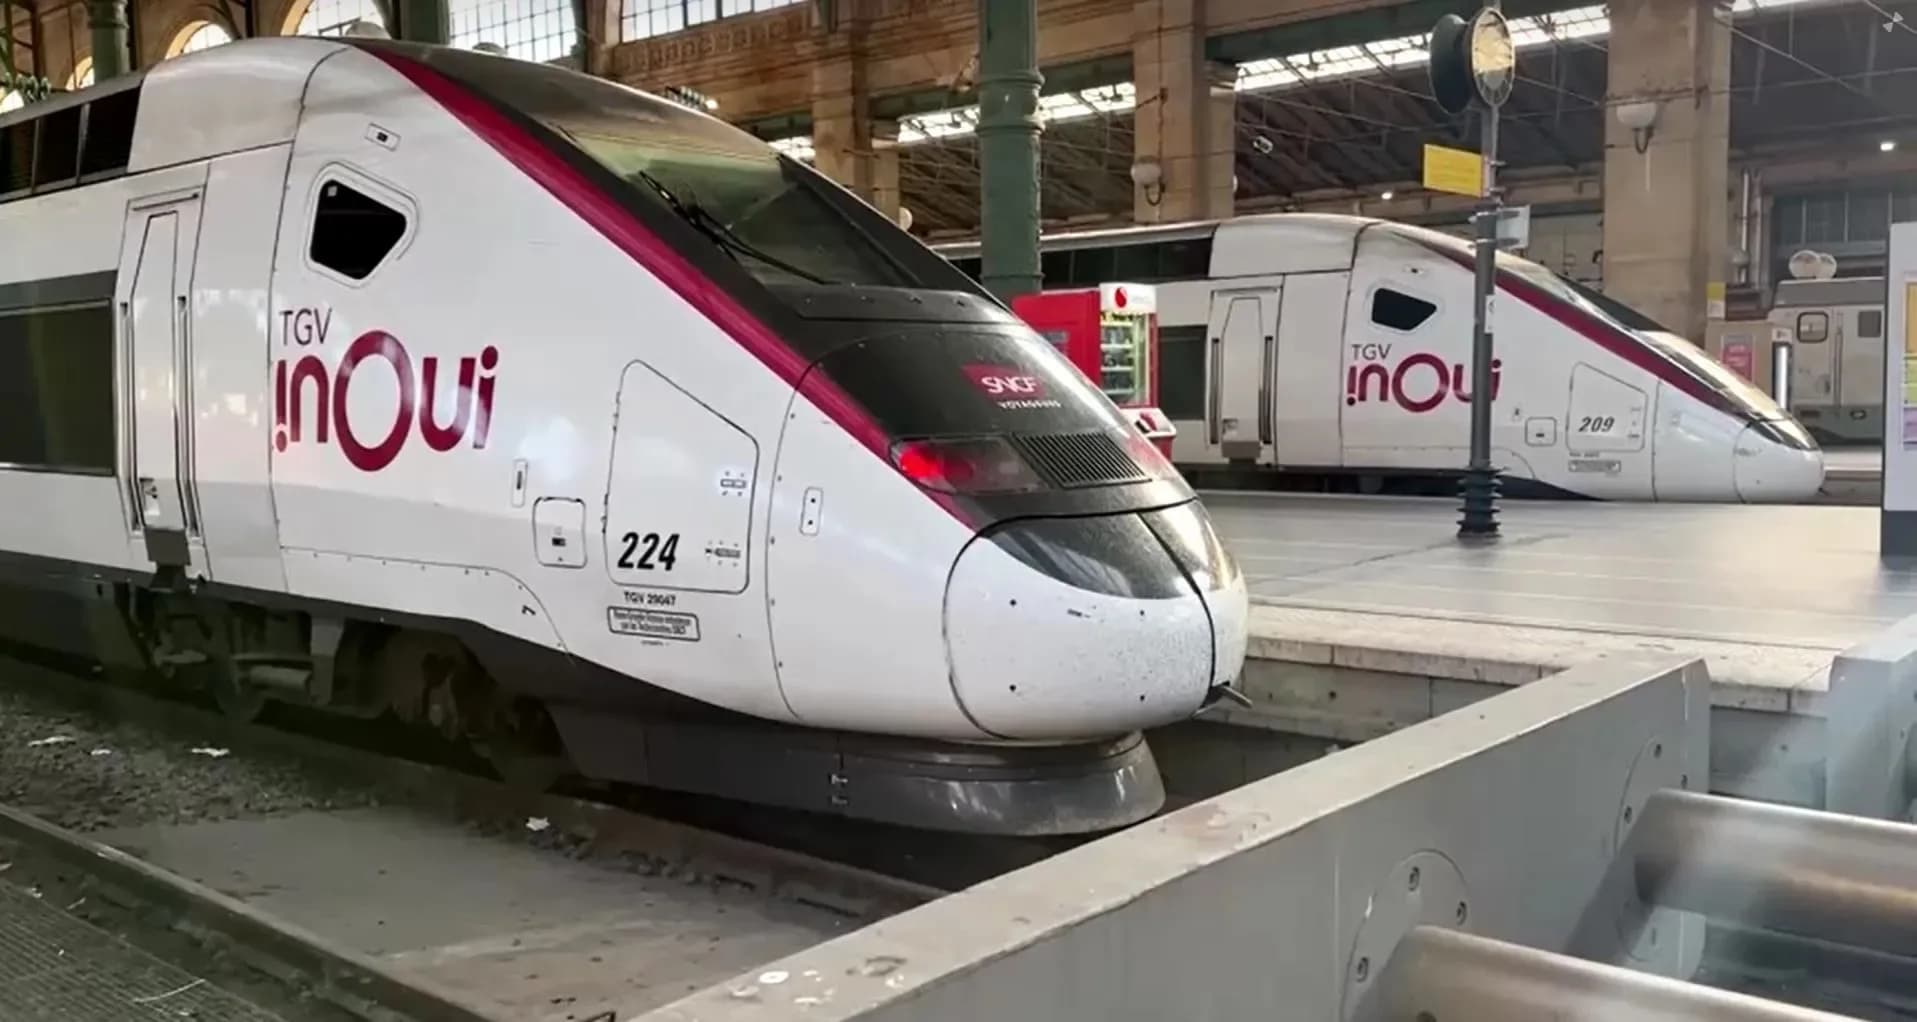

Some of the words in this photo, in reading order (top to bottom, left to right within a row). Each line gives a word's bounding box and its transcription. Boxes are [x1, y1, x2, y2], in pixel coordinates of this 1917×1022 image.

[279, 308, 332, 346] TGV
[1351, 343, 1392, 361] TGV
[981, 376, 1037, 393] SNCF
[1578, 416, 1616, 433] 209
[617, 531, 681, 571] 224
